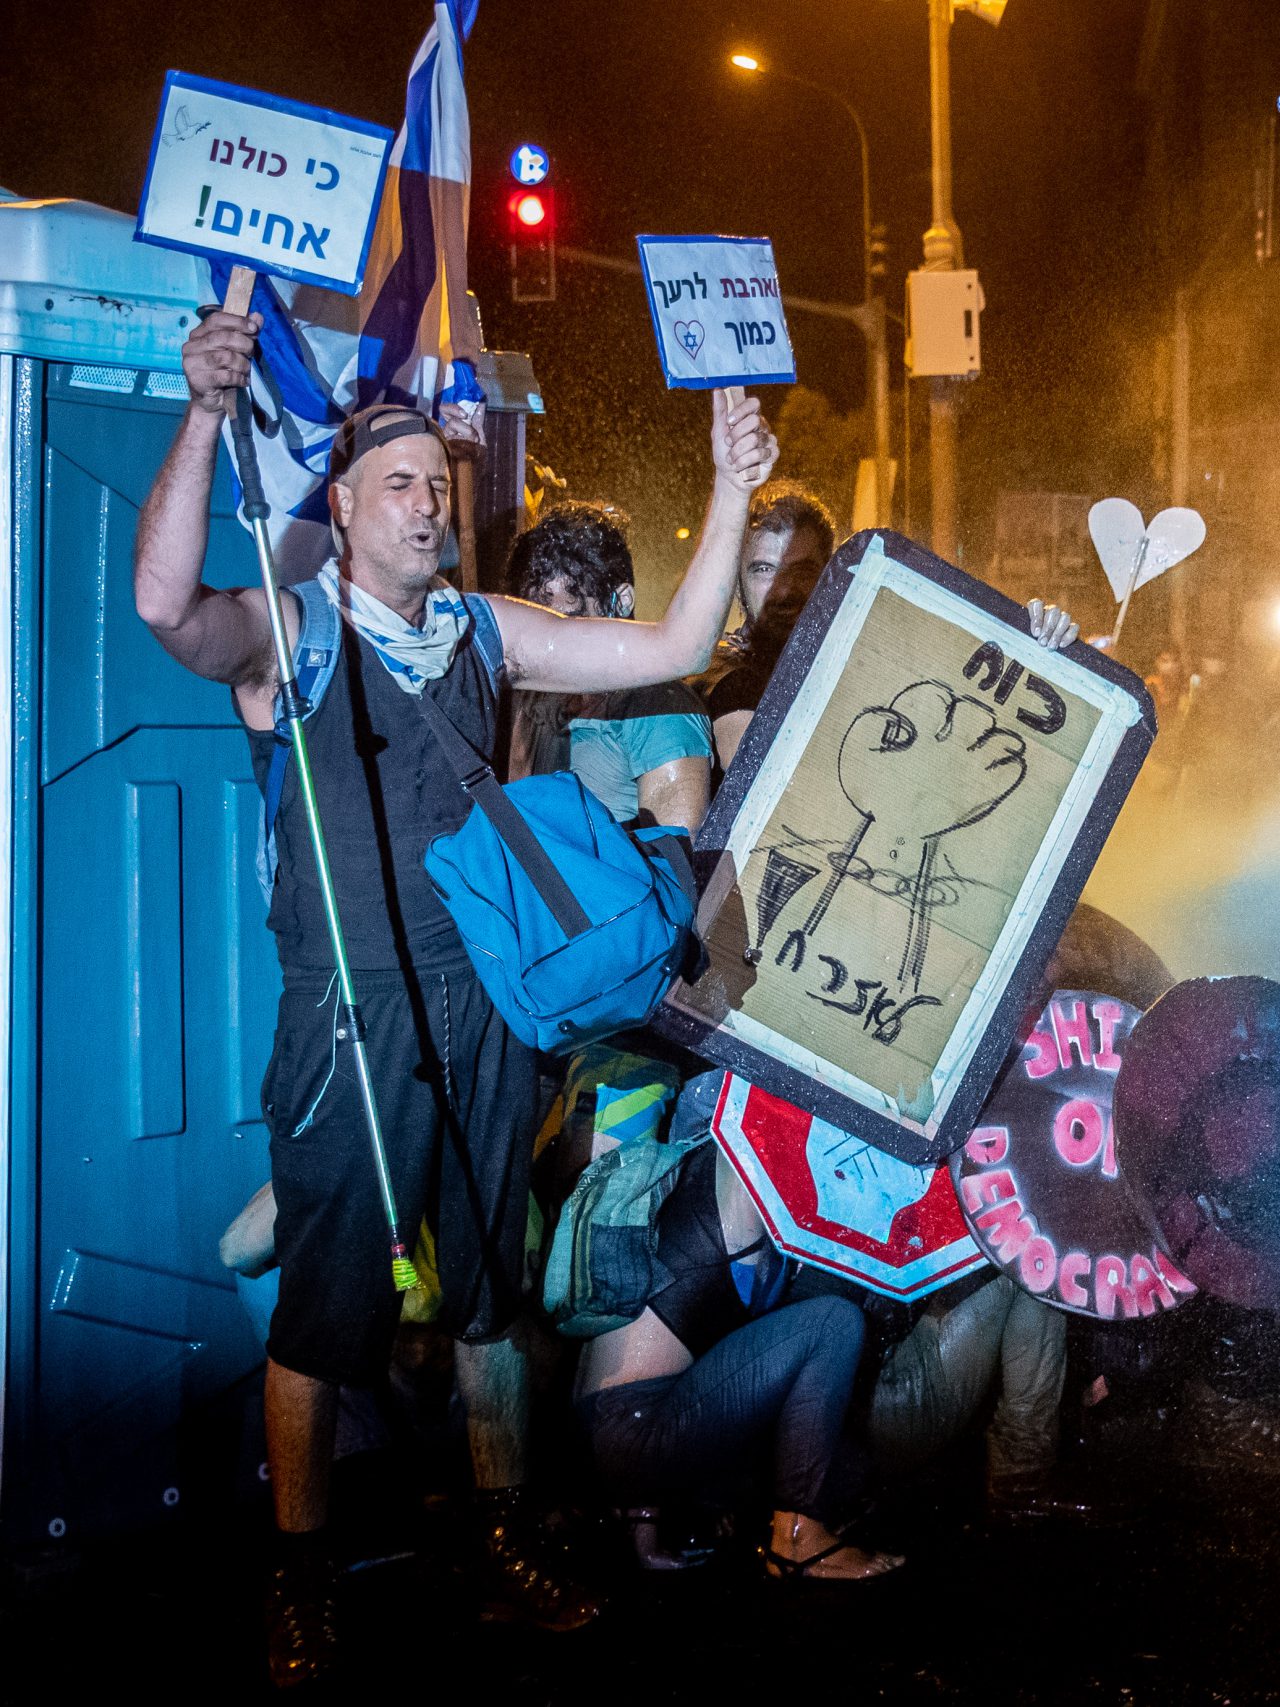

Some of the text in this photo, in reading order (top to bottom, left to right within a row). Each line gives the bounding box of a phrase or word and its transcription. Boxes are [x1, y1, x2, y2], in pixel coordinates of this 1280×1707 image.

[209, 136, 341, 191] כי כולנו
[194, 185, 331, 260] אחים!
[653, 271, 779, 309] ואהבת לרעך
[724, 320, 777, 354] כמוך
[962, 640, 1067, 735] כוח
[1054, 1099, 1119, 1178] O
[960, 1125, 1199, 1320] DEMOCRA
